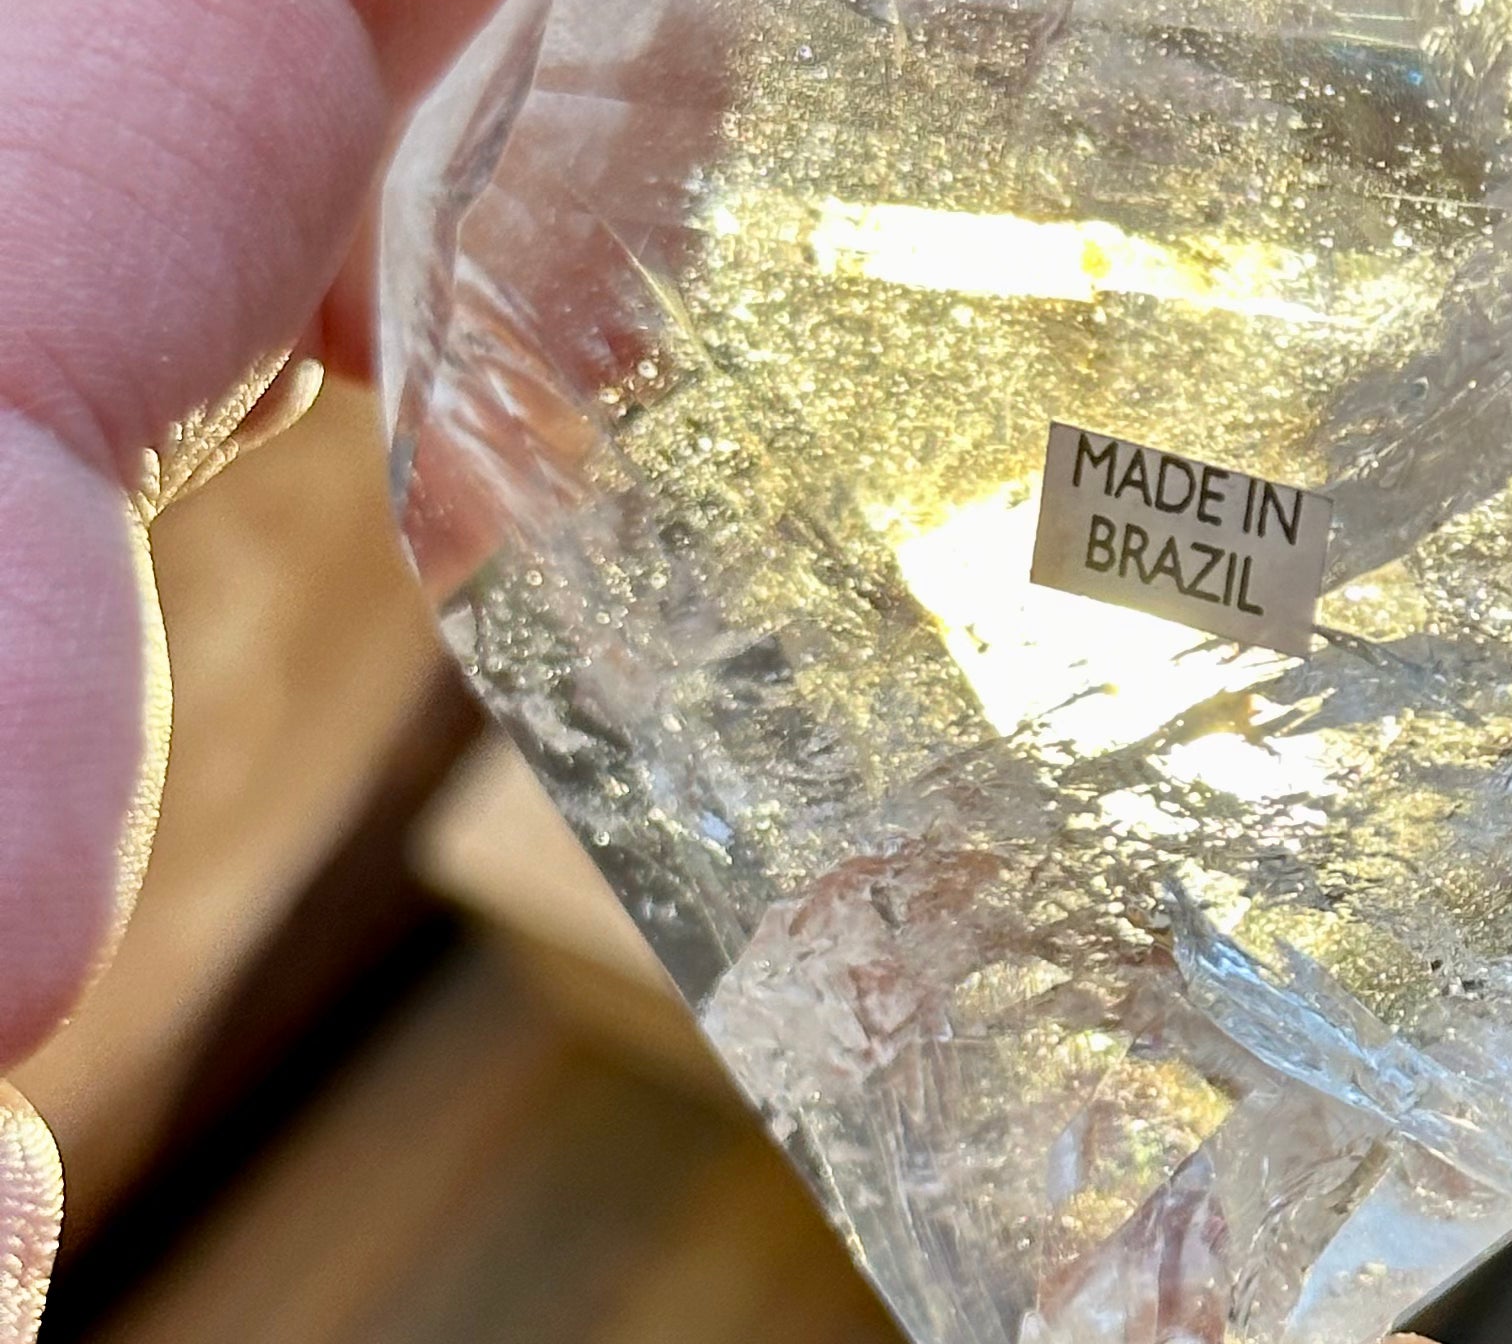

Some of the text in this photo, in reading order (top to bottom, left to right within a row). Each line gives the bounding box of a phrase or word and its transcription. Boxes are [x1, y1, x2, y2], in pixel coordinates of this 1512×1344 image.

[1072, 432, 1304, 545] MADE IN
[1085, 514, 1264, 616] BRAZIL
